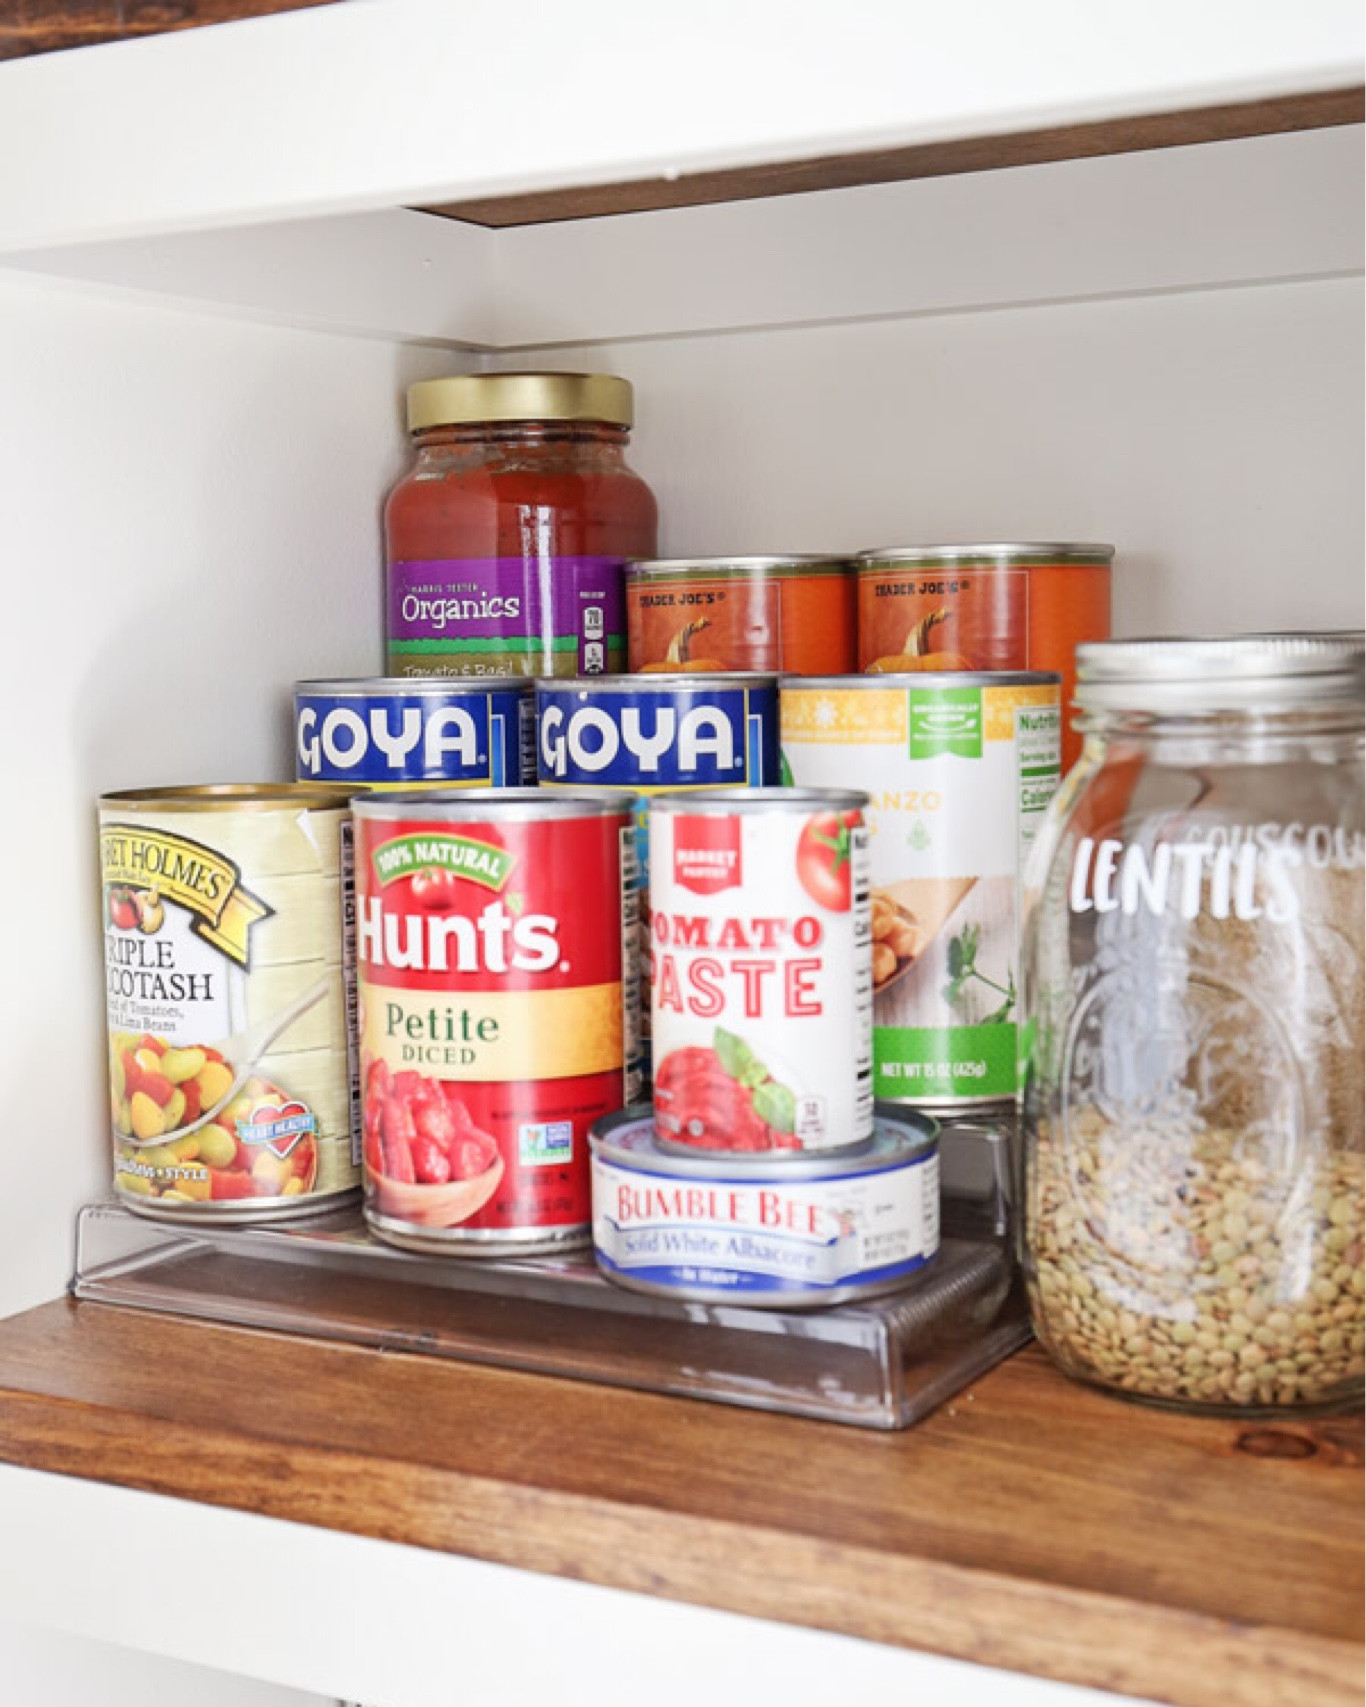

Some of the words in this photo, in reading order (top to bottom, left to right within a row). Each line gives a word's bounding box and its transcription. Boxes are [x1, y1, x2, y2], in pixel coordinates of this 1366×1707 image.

[639, 593, 676, 608] TRADER
[678, 591, 715, 606] JOE'S
[875, 583, 915, 597] TRADER
[918, 581, 959, 595] JOE'S
[402, 592, 520, 629] Organics
[299, 706, 478, 775] GOYA
[541, 704, 735, 777] GOYA
[870, 789, 942, 812] ANZO
[378, 846, 413, 873] 100%
[414, 841, 500, 878] NATURAL
[1188, 820, 1365, 870] COUSCOU
[131, 840, 225, 900] HOLMES
[1070, 837, 1300, 923] LENTILS
[651, 910, 823, 951] OMATO
[108, 935, 176, 969] RIPLE
[109, 966, 215, 1002] COTASH
[386, 1002, 500, 1043] Petite
[402, 1044, 477, 1065] DICED
[881, 1062, 901, 1077] NET
[165, 1166, 210, 1181] STYLE
[617, 1183, 745, 1223] BUMBLE
[758, 1188, 827, 1235] BEE
[662, 1233, 719, 1254] White
[727, 1237, 816, 1269] Albacore
